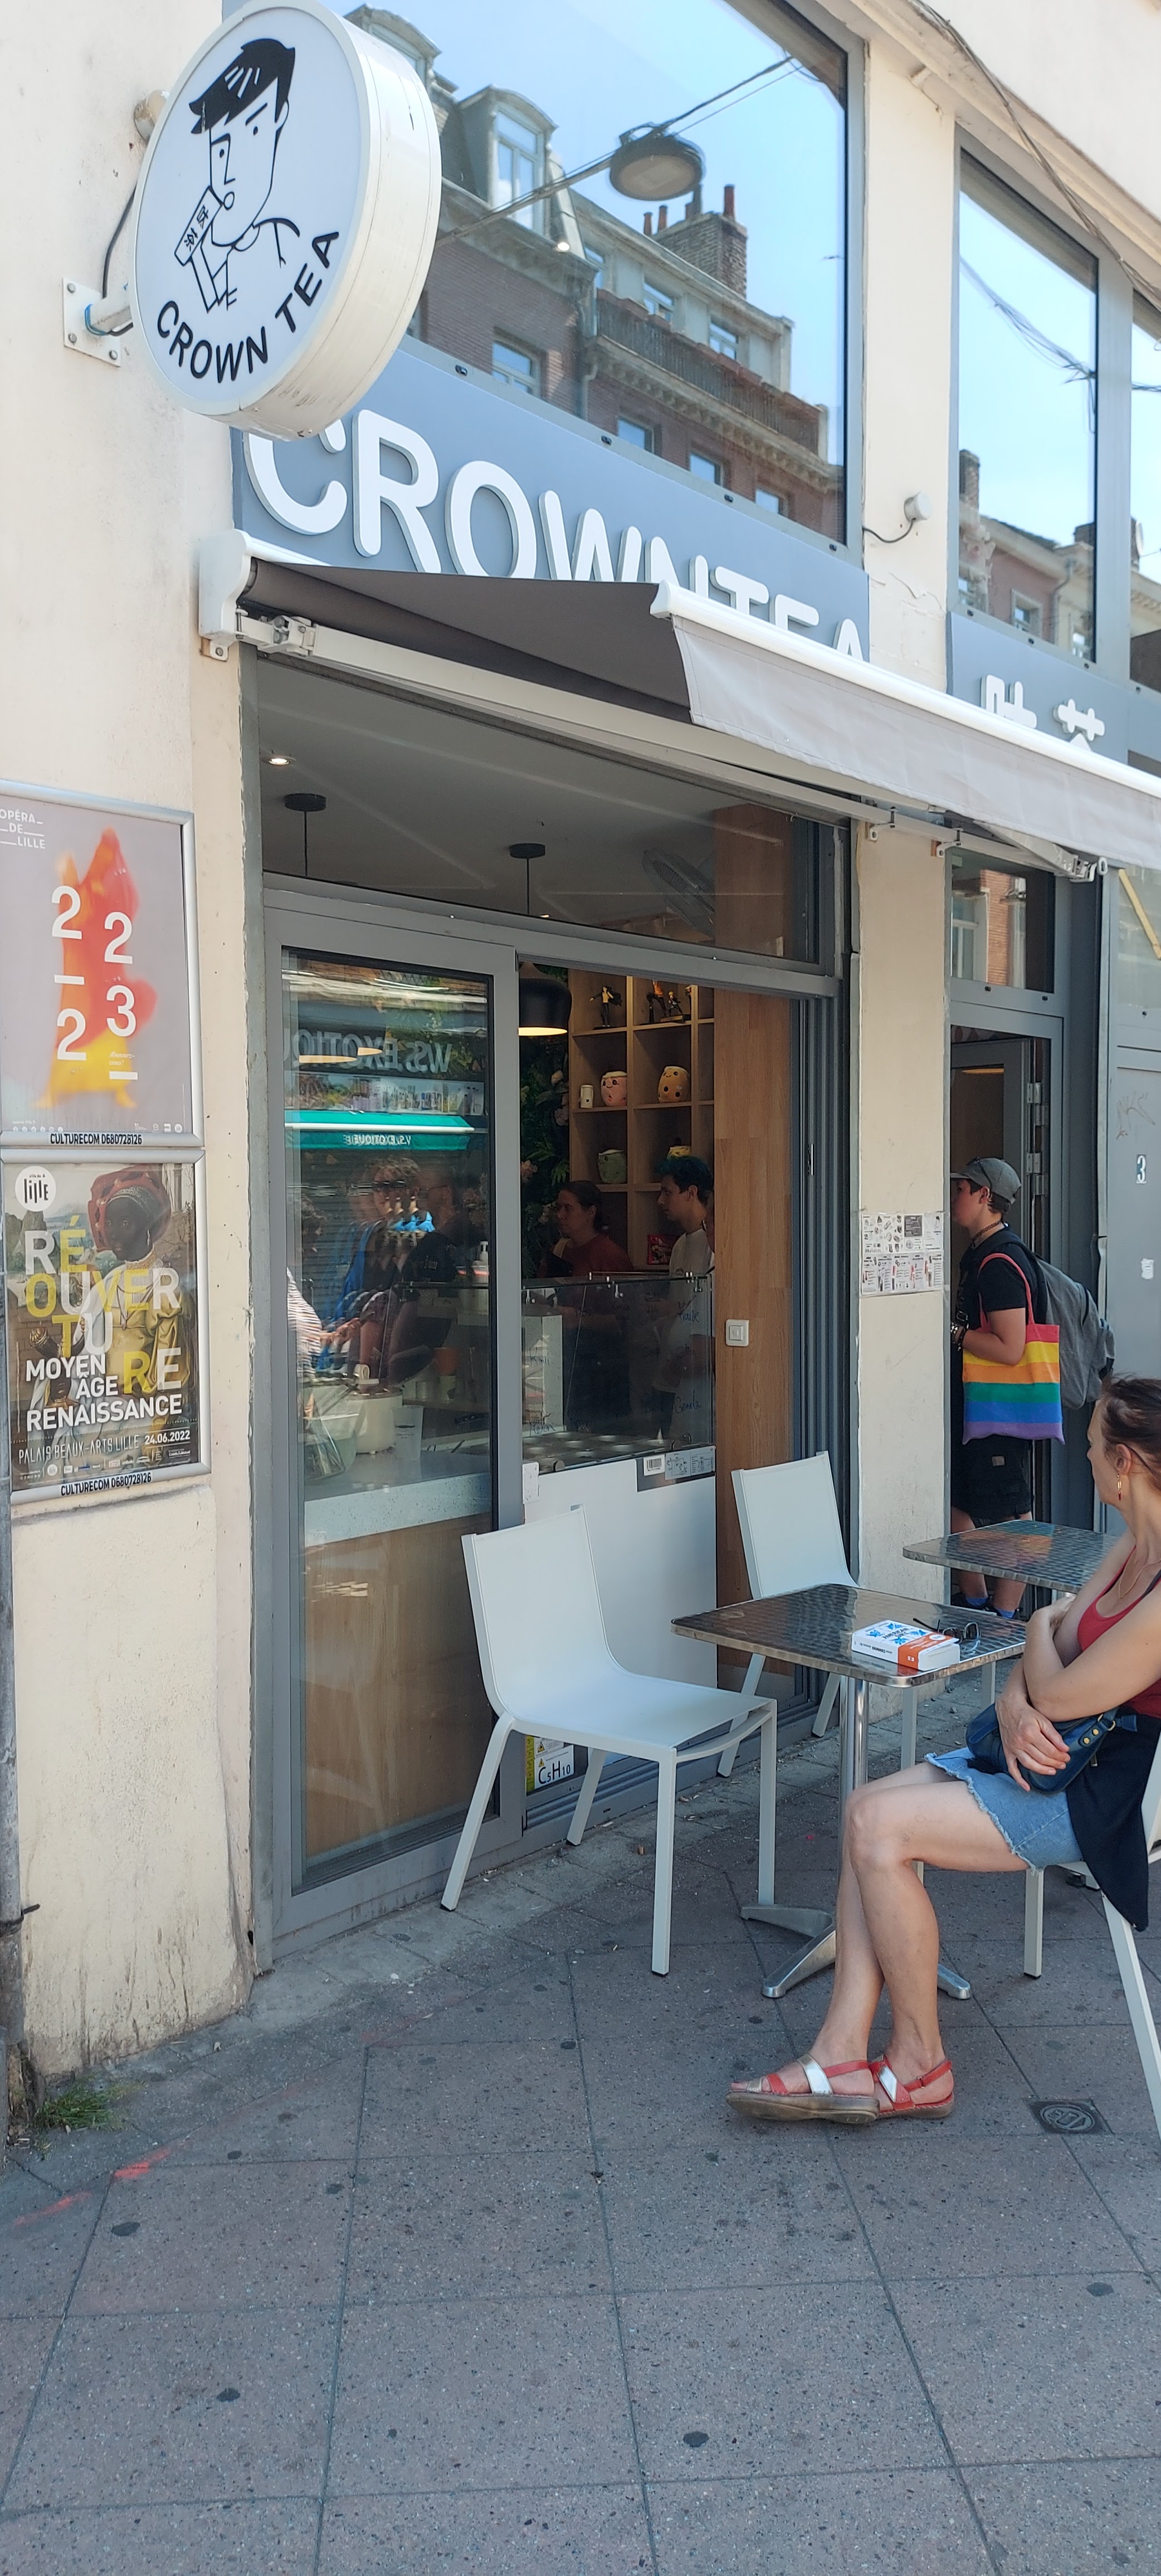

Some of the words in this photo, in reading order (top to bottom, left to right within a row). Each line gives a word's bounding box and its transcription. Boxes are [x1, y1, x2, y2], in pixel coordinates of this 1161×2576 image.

[157, 301, 268, 383] CROWN
[275, 231, 339, 333] TEA
[0, 809, 36, 824] OPÉRA
[9, 823, 23, 834] DE
[17, 836, 45, 849] LILLE
[50, 1133, 100, 1145] CULTURECOM
[101, 1134, 142, 1145] 0680728126
[1136, 1155, 1147, 1183] 3
[25, 1215, 87, 1275] RÉ
[26, 1267, 181, 1318] OUVER
[52, 1311, 113, 1358] TU
[26, 1353, 106, 1382] MOYEN
[123, 1347, 182, 1394] RE
[76, 1373, 119, 1399] ÂGE
[27, 1394, 182, 1432] RENAISSANCE
[19, 1446, 51, 1465] PALAIS
[116, 1435, 140, 1452] LILLE
[144, 1430, 191, 1445] 24.06.2022
[61, 1478, 110, 1496] CULTURECOM
[111, 1472, 152, 1488] 0680728126
